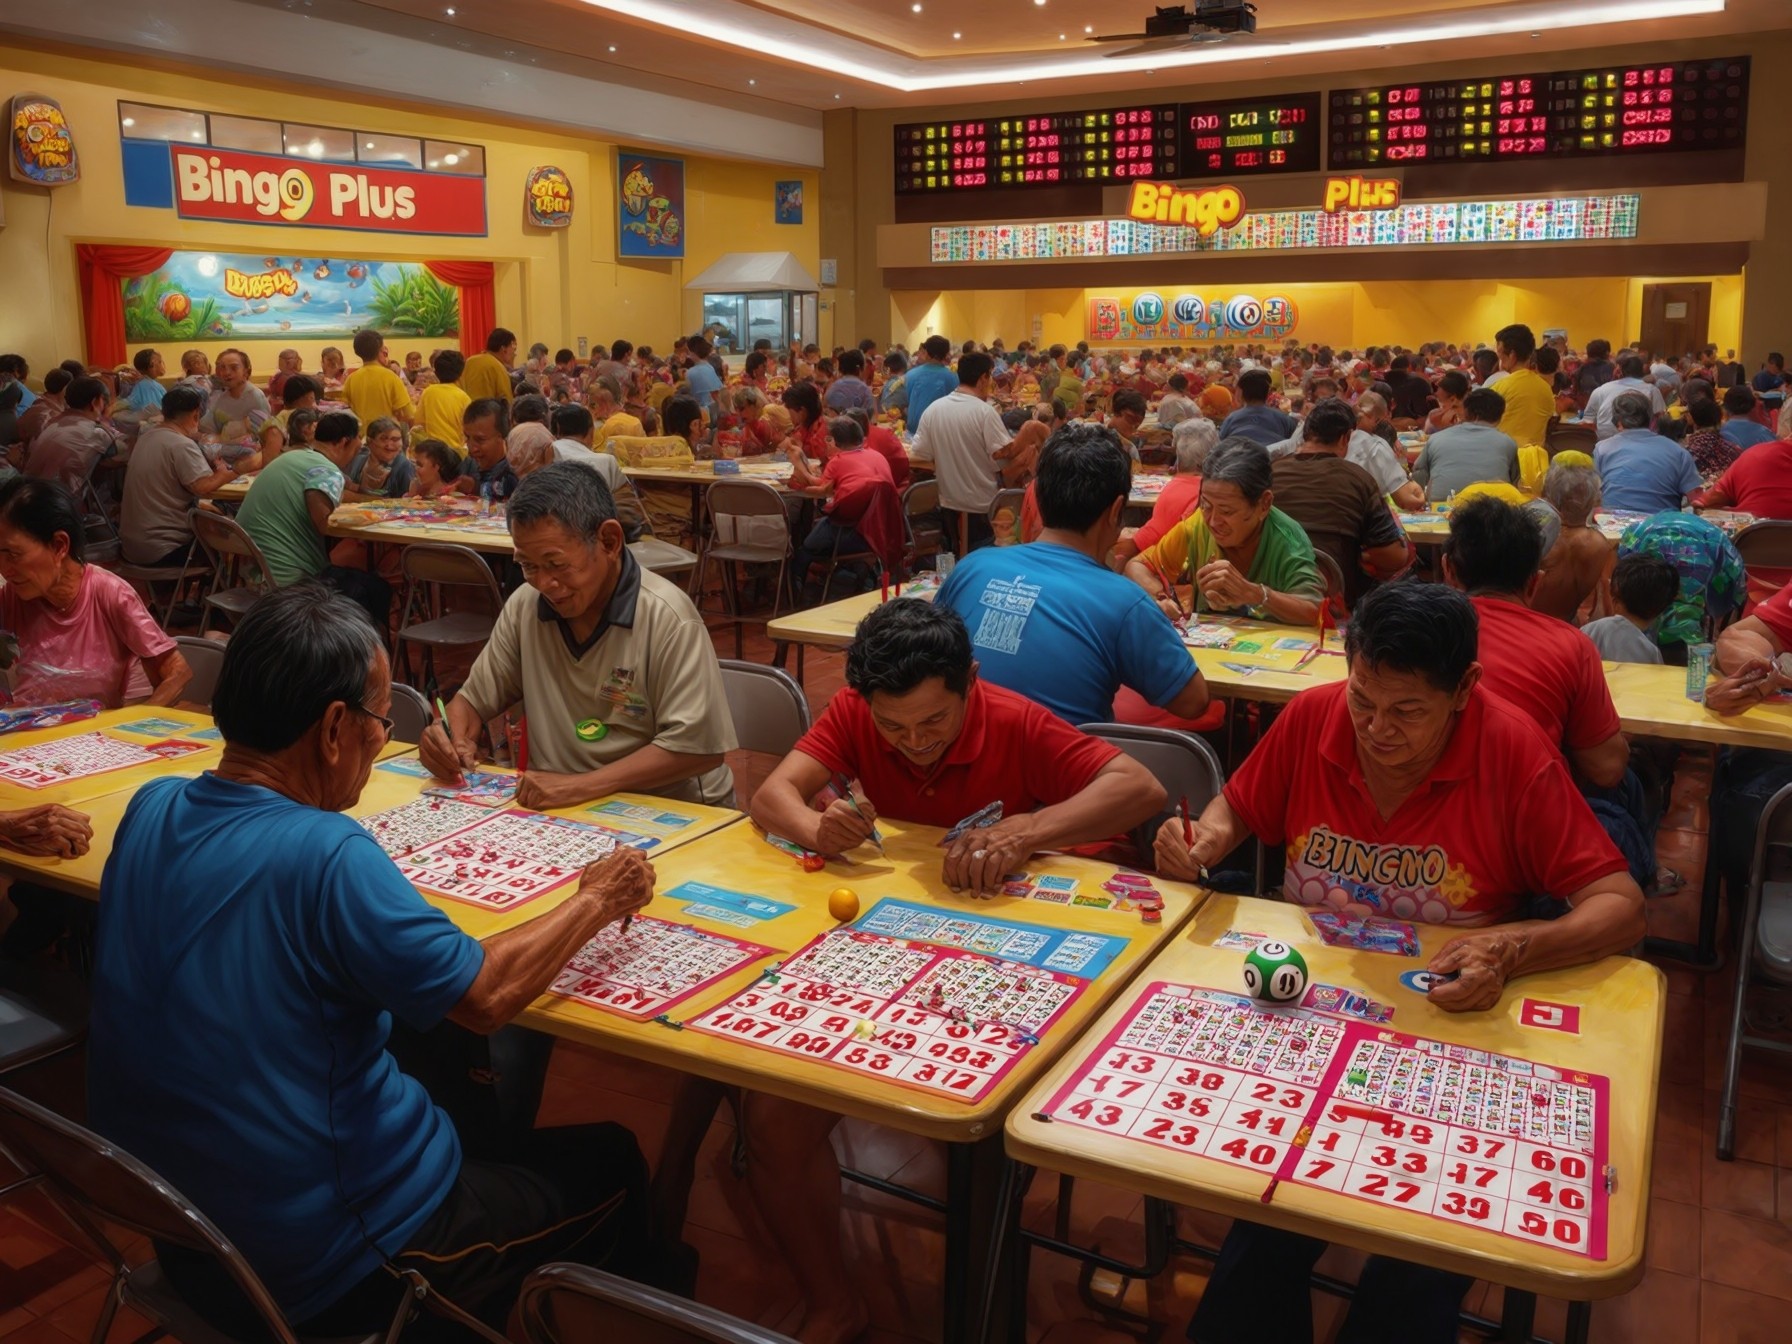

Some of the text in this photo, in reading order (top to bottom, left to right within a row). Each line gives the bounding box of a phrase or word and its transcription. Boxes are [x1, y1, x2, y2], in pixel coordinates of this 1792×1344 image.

[329, 173, 416, 219] Plus
[1130, 182, 1240, 236] Bingo
[1250, 1083, 1306, 1109] 23
[1068, 1098, 1277, 1165] 43 23 40
[1371, 1145, 1427, 1173] 33
[1457, 1135, 1506, 1159] 37
[1531, 1150, 1586, 1179] 60
[1359, 1173, 1421, 1203] 27
